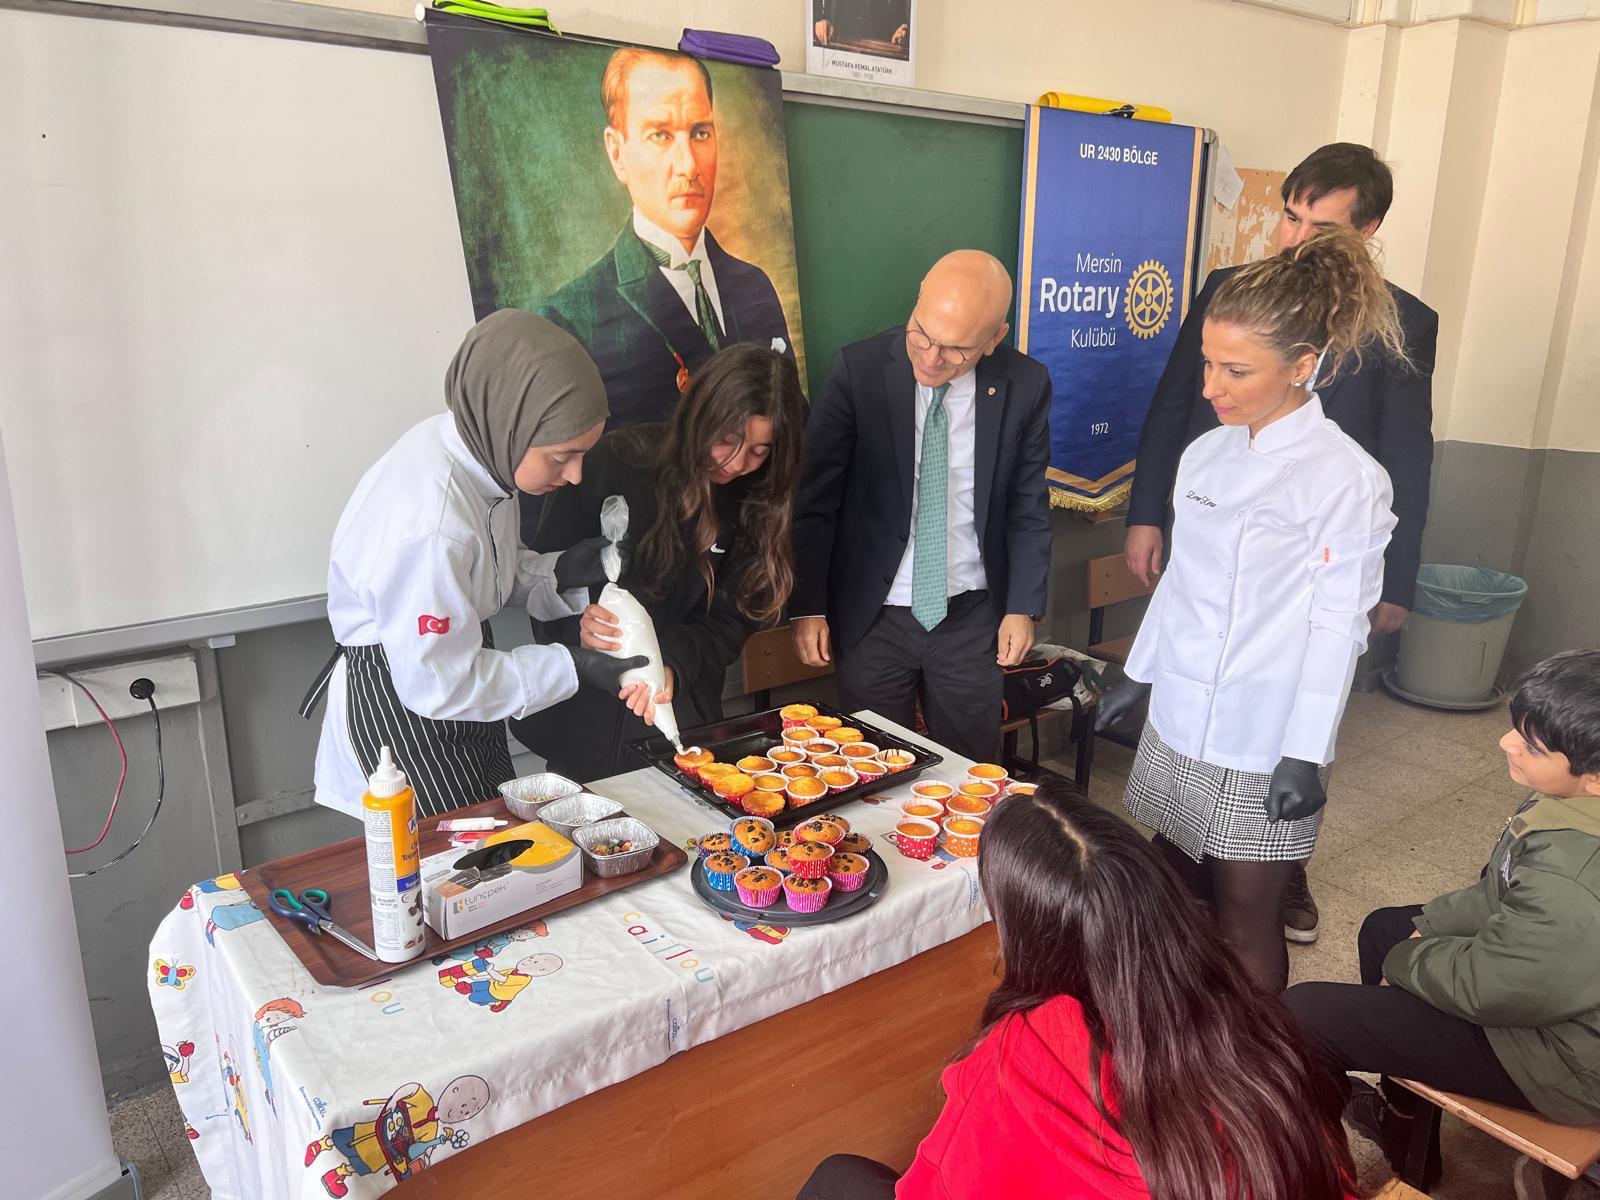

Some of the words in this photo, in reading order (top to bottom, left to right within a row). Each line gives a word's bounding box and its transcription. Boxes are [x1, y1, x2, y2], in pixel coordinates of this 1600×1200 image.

[831, 60, 853, 68] MUSTAFA
[1080, 143, 1096, 159] UR
[1098, 145, 1121, 162] 2430
[1123, 145, 1158, 165] BÖLGE
[1076, 252, 1122, 273] Mersin
[1039, 277, 1119, 318] Rotary
[1071, 327, 1116, 348] Kulübü
[1090, 423, 1109, 435] 1972
